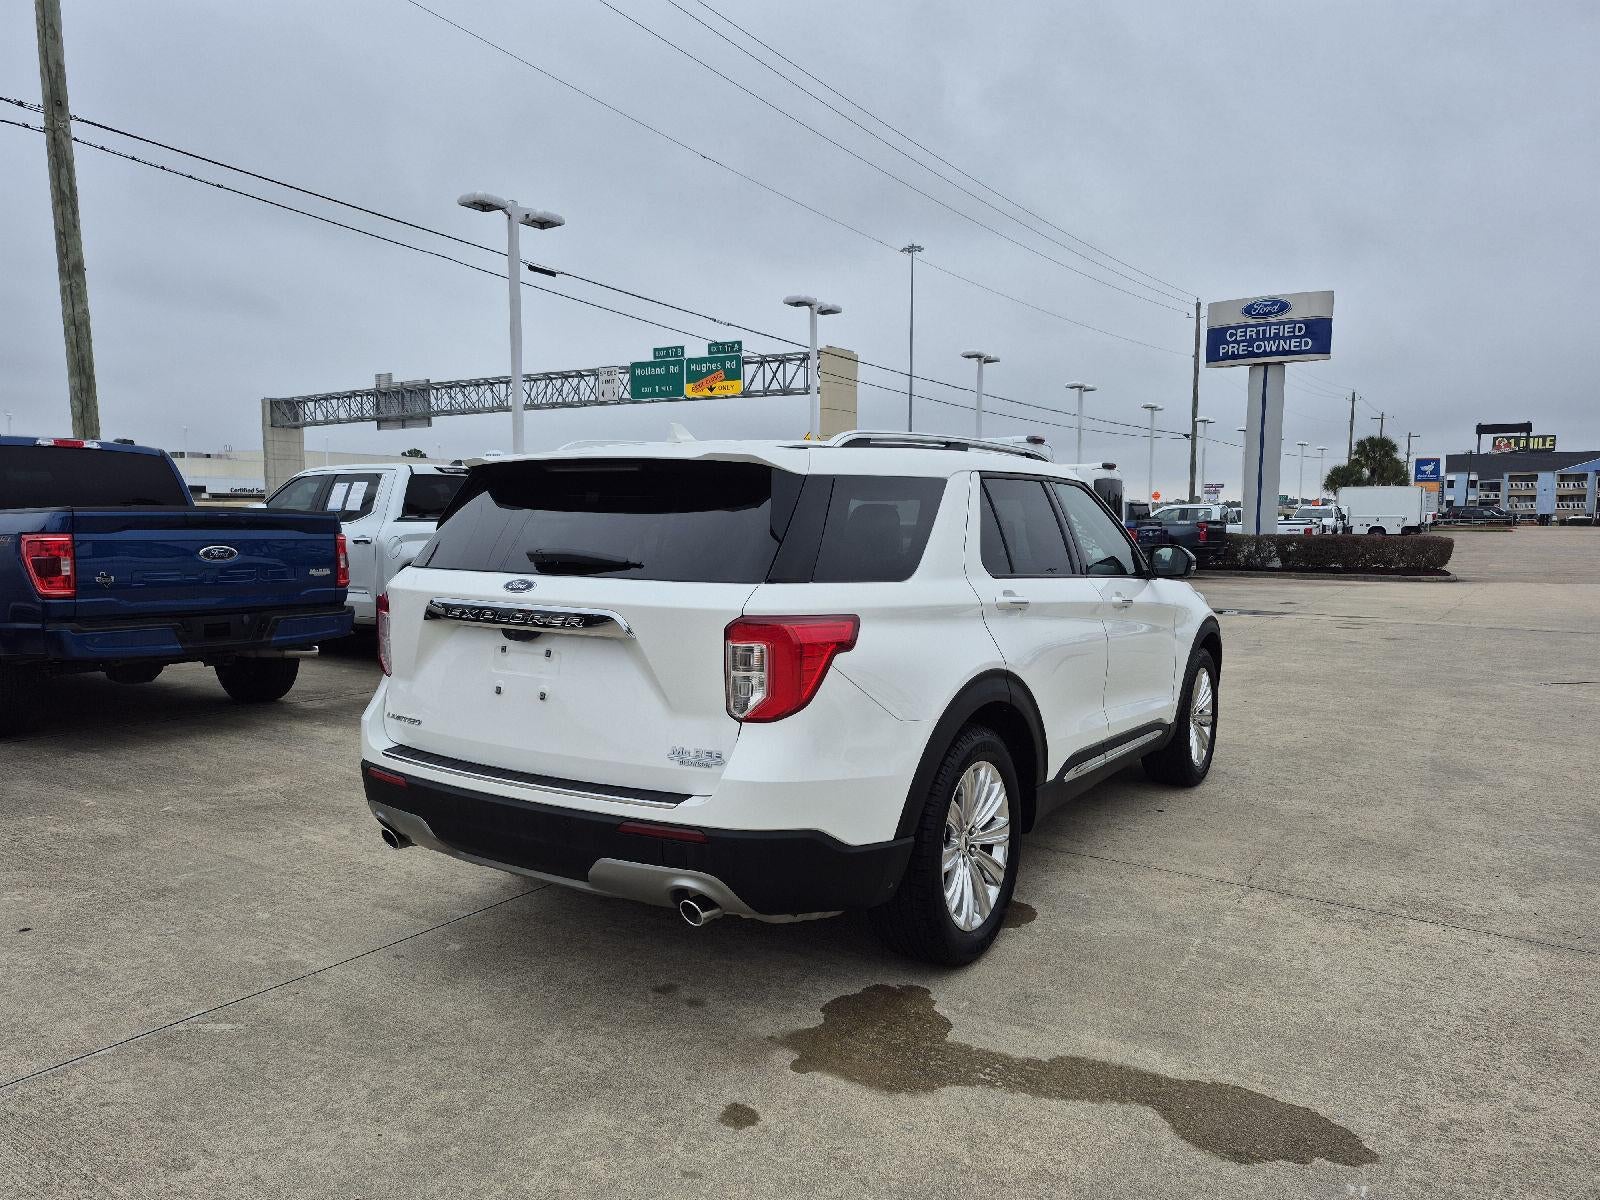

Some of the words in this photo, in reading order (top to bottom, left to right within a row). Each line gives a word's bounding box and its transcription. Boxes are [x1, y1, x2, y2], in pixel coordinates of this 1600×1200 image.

[1251, 302, 1280, 315] Ford
[1226, 323, 1306, 341] CERTIFIED
[1219, 338, 1312, 357] PRE-OWNED
[635, 367, 665, 376] Holland
[669, 364, 679, 374] Rd
[690, 362, 721, 373] Hughes
[725, 360, 736, 369] Rd
[209, 549, 230, 559] Ford
[508, 579, 527, 589] Ford
[448, 608, 585, 628] EXPLORER
